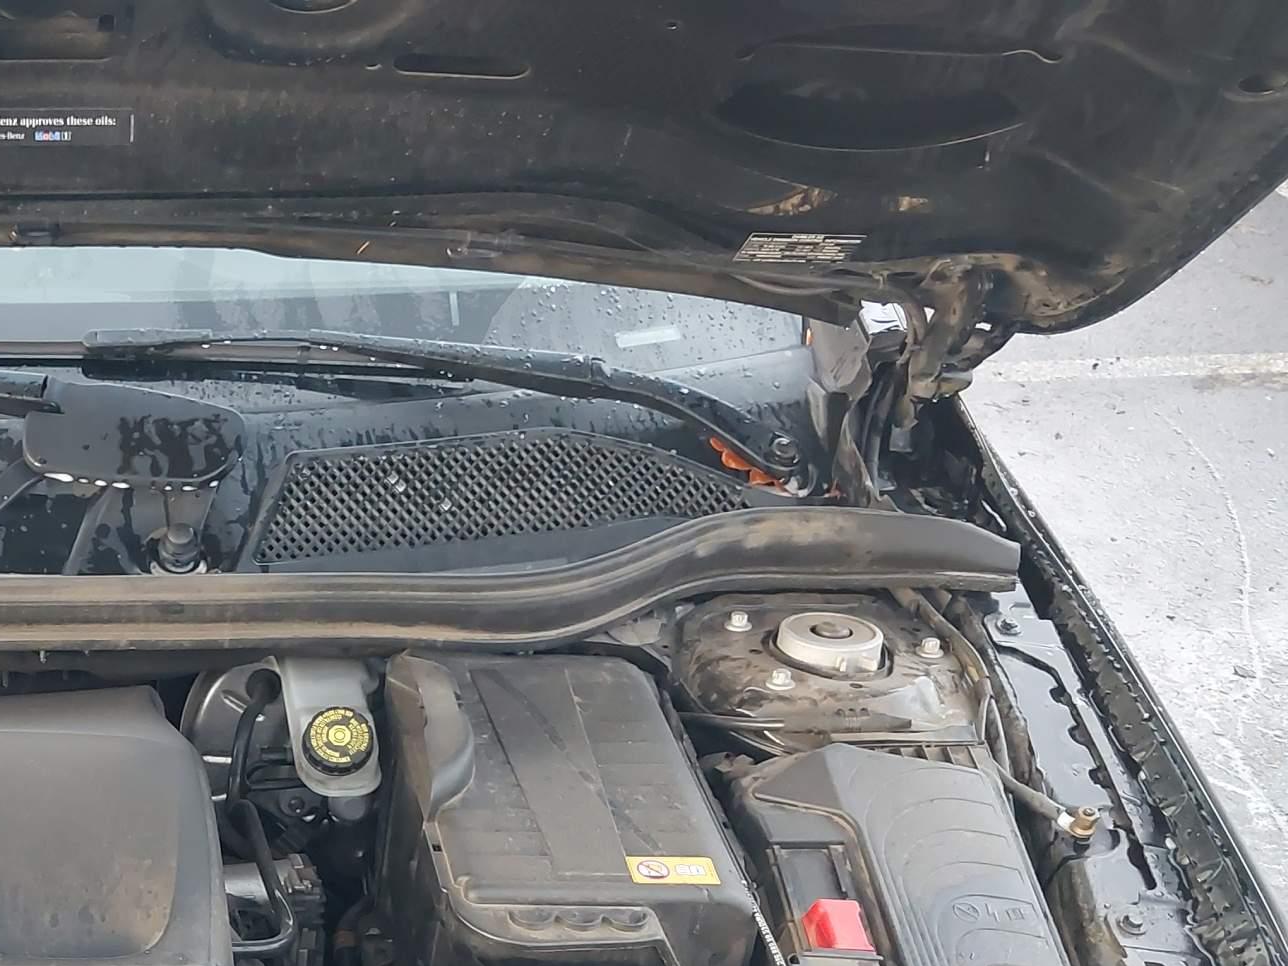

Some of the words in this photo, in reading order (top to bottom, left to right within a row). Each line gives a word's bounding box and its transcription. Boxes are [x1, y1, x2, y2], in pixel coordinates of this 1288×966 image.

[20, 117, 64, 128] approves
[66, 115, 93, 126] these
[95, 115, 117, 126] oils:
